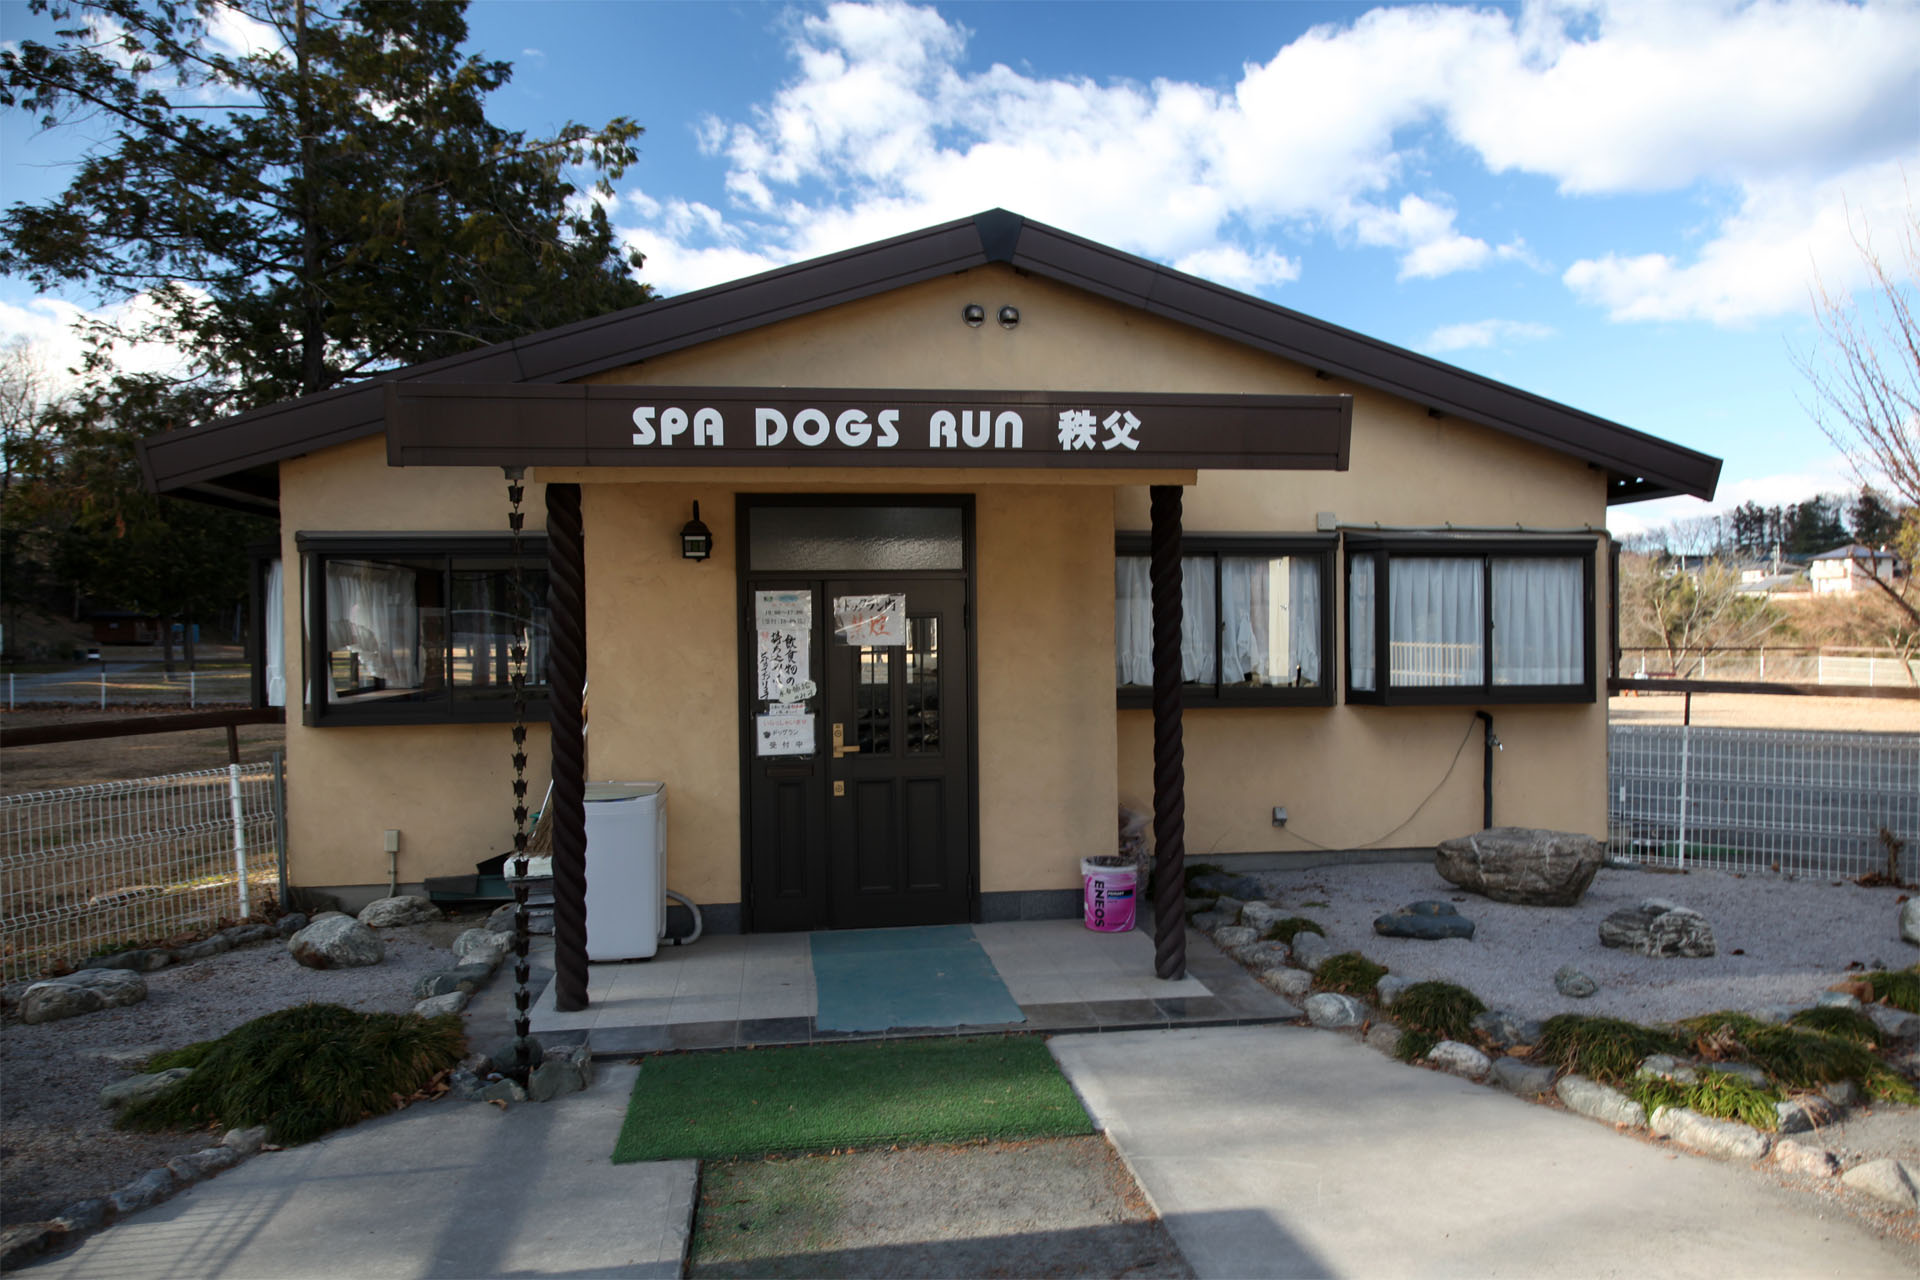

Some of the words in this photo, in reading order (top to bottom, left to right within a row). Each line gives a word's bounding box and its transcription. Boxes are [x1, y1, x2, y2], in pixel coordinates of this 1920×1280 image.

[633, 407, 723, 445] SPA
[756, 408, 899, 446] DOGS
[930, 411, 1022, 447] RUN
[1058, 410, 1141, 450] 秩父
[1095, 880, 1104, 927] ENEOS
